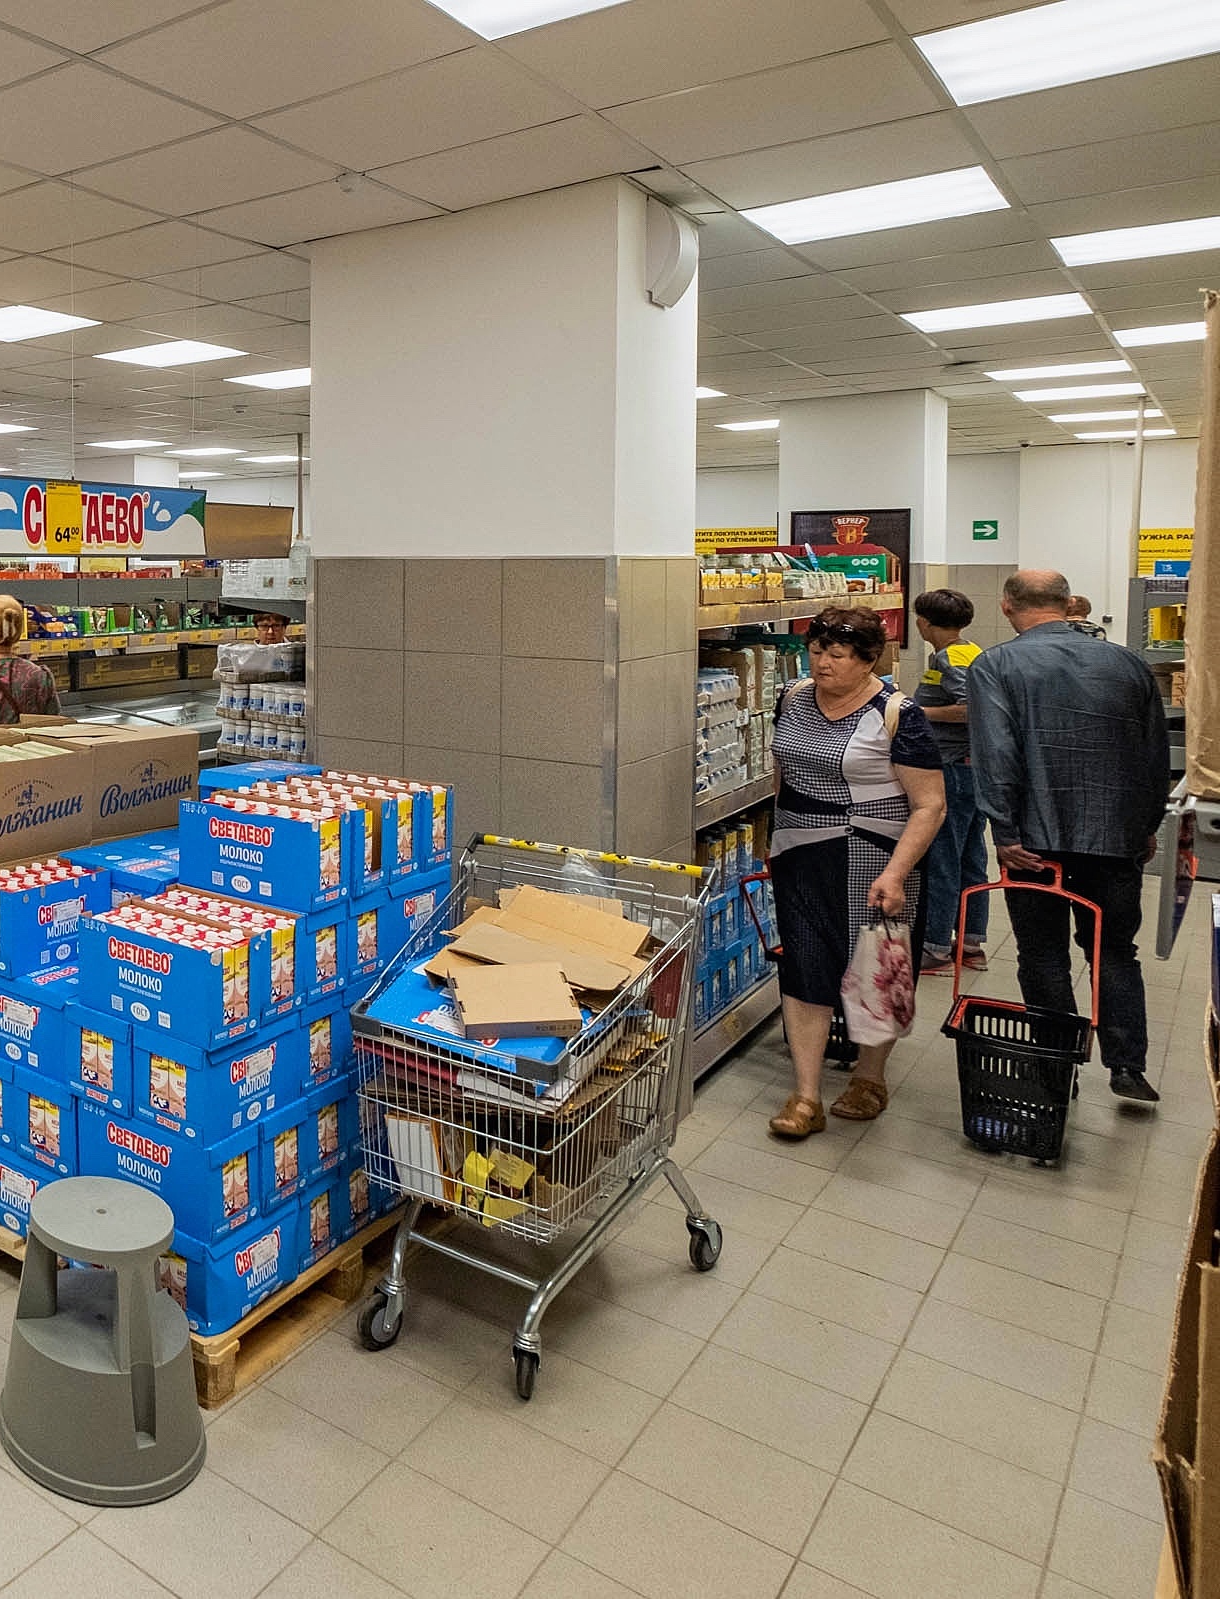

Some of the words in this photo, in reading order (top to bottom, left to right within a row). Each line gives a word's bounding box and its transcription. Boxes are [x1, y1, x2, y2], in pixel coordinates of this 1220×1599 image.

[23, 486, 144, 545] САЕВО
[100, 773, 193, 818] Волжанин
[209, 817, 274, 848] СВЕТАЕВО
[220, 844, 264, 865] МОЛОКО
[109, 937, 172, 975] СВЕТАЕВО
[118, 966, 162, 993] МОЛОКО
[133, 1003, 149, 1018] ГОСТ
[107, 1121, 171, 1167] СВЕТАЕВО
[117, 1152, 161, 1184] МОЛОКО
